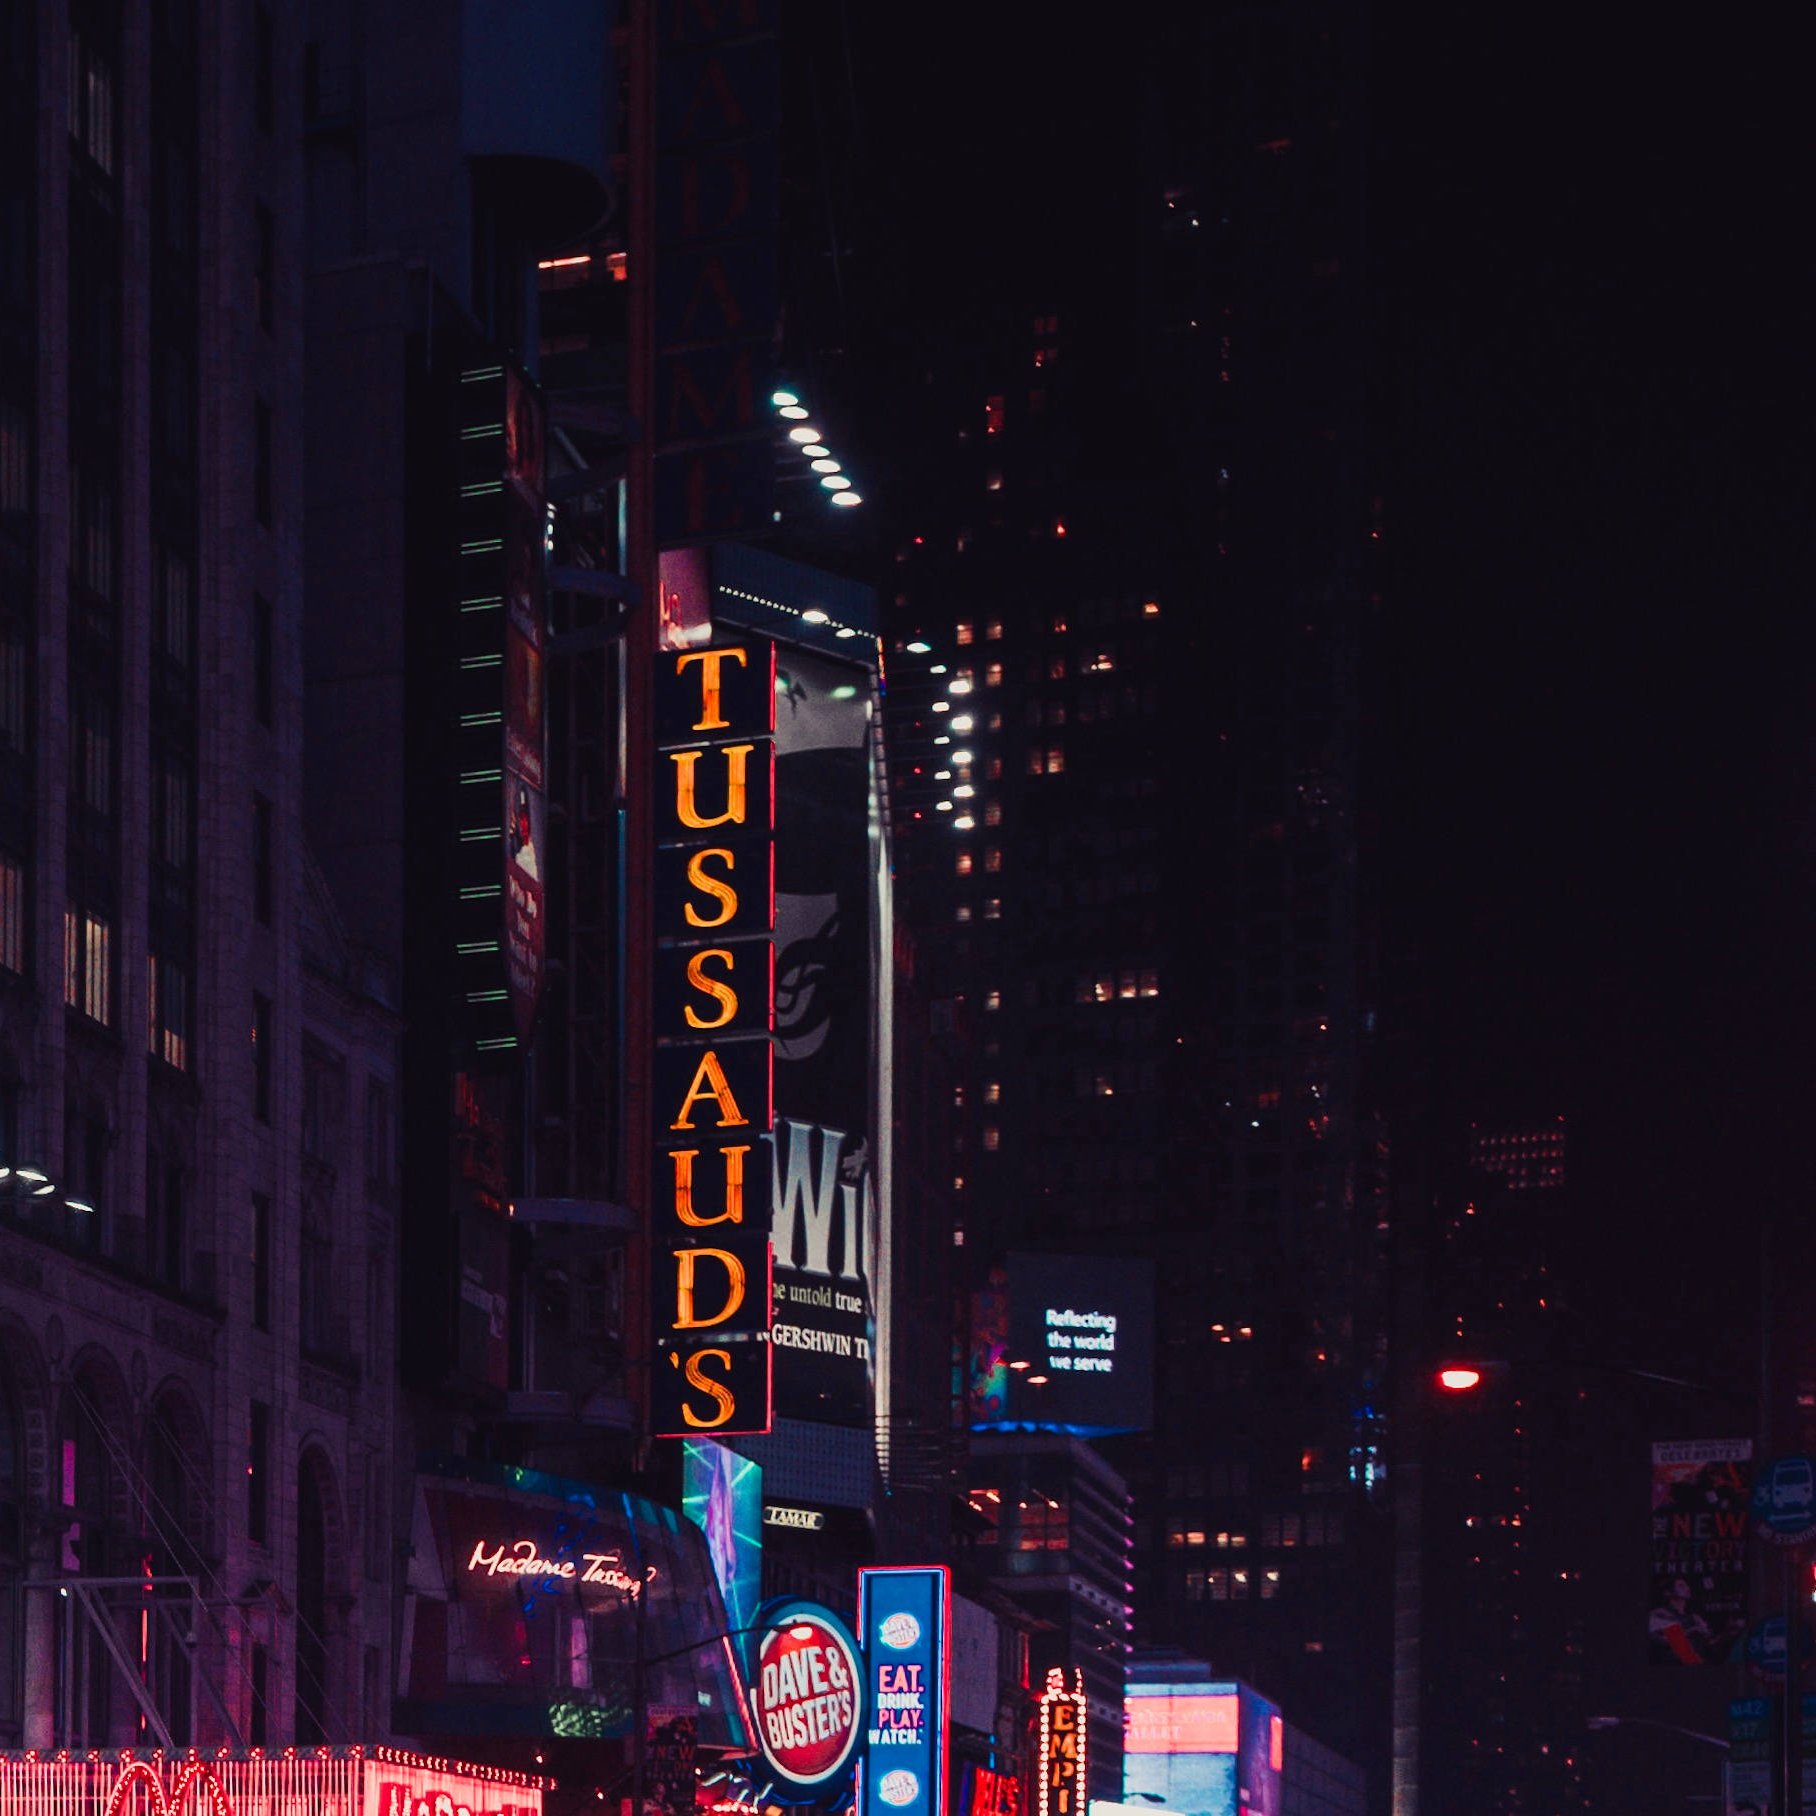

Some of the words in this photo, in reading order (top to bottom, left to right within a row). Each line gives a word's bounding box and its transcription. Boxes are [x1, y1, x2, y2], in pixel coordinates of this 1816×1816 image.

[669, 646, 755, 1428] TUSSAUD'S
[790, 1286, 832, 1308] untold
[835, 1291, 863, 1313] true
[1046, 1309, 1117, 1333] Reflecting
[772, 1323, 851, 1356] GERSHWIN
[1047, 1330, 1072, 1349] the
[1073, 1333, 1115, 1350] world
[1049, 1355, 1072, 1370] we
[1073, 1356, 1113, 1372] serve
[1672, 1512, 1749, 1538] NEW
[469, 1541, 575, 1578] Madame
[1652, 1541, 1746, 1562] VICTORY
[763, 1648, 828, 1710] DAVE
[829, 1645, 849, 1688] &
[879, 1664, 924, 1694] EAT.
[767, 1697, 853, 1751] BUSTER'S
